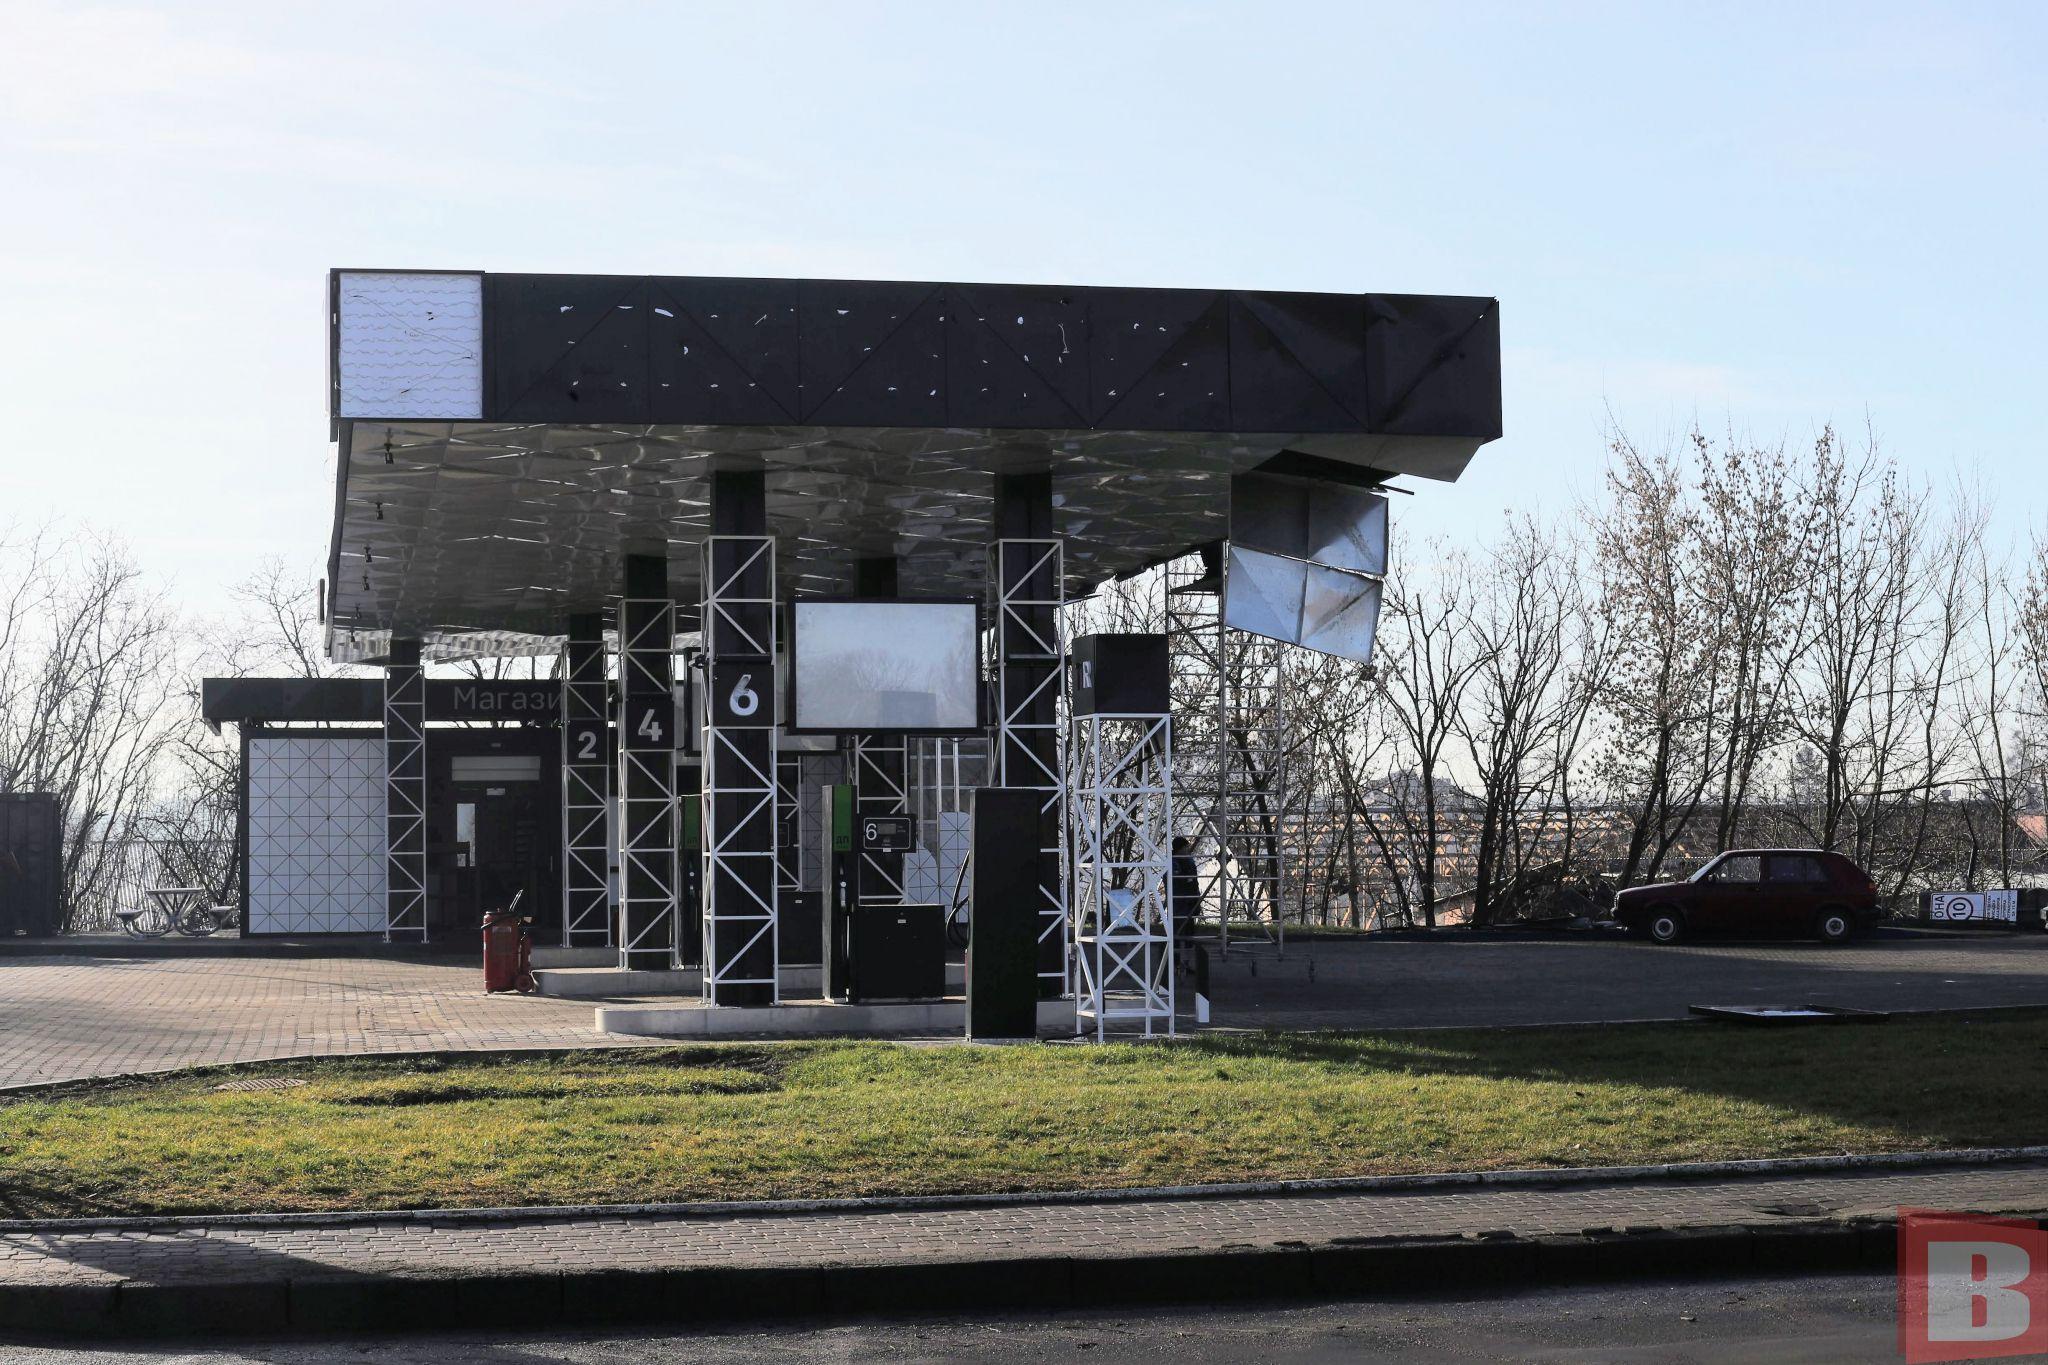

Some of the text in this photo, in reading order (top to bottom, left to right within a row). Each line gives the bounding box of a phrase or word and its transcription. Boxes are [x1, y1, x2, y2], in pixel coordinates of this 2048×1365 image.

[454, 686, 562, 710] Магази
[729, 674, 759, 716] 6
[638, 708, 663, 742] 4
[578, 731, 597, 759] 2
[866, 823, 877, 840] 6
[1934, 895, 1944, 919] ОНА
[1953, 902, 1966, 918] 10
